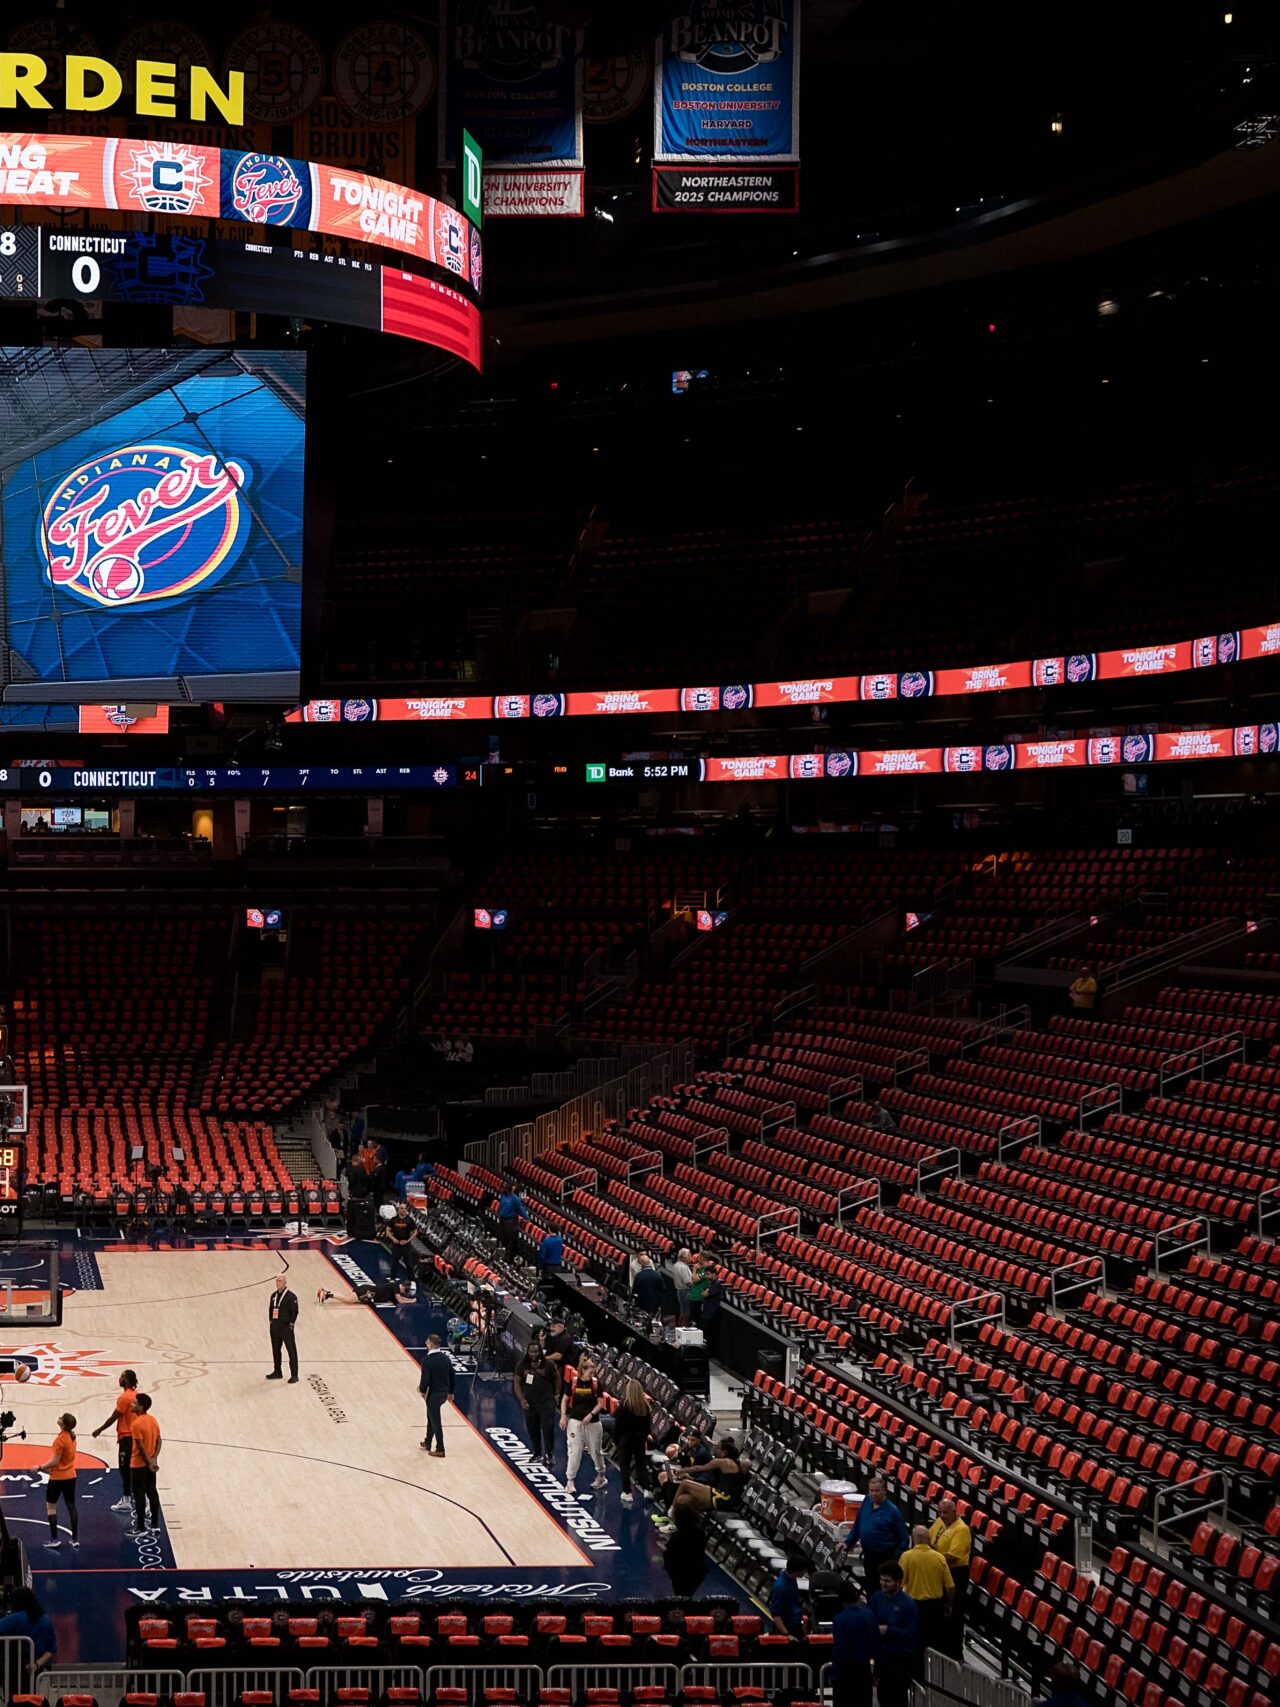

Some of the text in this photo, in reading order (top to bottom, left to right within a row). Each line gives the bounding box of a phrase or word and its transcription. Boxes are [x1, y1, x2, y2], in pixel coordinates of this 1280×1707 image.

[671, 16, 788, 53] BEANPOT
[376, 60, 393, 87] 4
[682, 82, 773, 92] BOSTON COLLEGE
[673, 100, 781, 110] BOSTON UNIVERSITY
[701, 119, 753, 128] HARVARD
[242, 154, 290, 176] INDIANA
[504, 181, 570, 192] UNIVERSITY
[681, 176, 772, 187] NORTHEASTERN
[234, 168, 302, 211] Fever
[329, 176, 423, 223] TONIGHT
[493, 196, 565, 207] CHAMPIONS
[674, 191, 779, 202] 2025 CHAMPIONS
[359, 208, 418, 246] GAME
[49, 235, 127, 255] CONNECTICUT
[16, 274, 23, 283] 0
[71, 256, 101, 293] 0
[16, 284, 23, 292] 5
[54, 452, 171, 512] INDIANA
[47, 453, 246, 585] Fever
[1122, 648, 1176, 663] TONIGHT'S
[1134, 660, 1165, 672] GAME
[972, 668, 1000, 680] BRING
[778, 681, 833, 694] TONIGHT'S
[965, 679, 983, 690] THE
[604, 692, 640, 704] BRING
[790, 691, 820, 701] GAME
[406, 700, 466, 711] TONIGHT'S
[596, 700, 649, 712] THE HEAT
[419, 708, 452, 717] GAME
[1177, 735, 1211, 747] BRING
[1027, 743, 1076, 756] TONIGHT'S
[1169, 743, 1220, 757] THE HEAT
[882, 752, 917, 763] BRING
[1036, 753, 1064, 764] GAME
[720, 759, 776, 771] TONIGHT'S
[875, 760, 926, 772] THE HEAT
[465, 770, 477, 780] 24
[589, 766, 634, 779] TD Bank
[644, 765, 689, 778] 5:52 PM
[734, 767, 765, 778] GAME
[39, 771, 156, 788] 0 CONNECTICUT
[188, 777, 215, 787] 0 5
[484, 1426, 621, 1551] @CONNECTICUTSUN
[277, 1568, 446, 1585] Courtside
[127, 1580, 613, 1600] Michelob ULTRA
